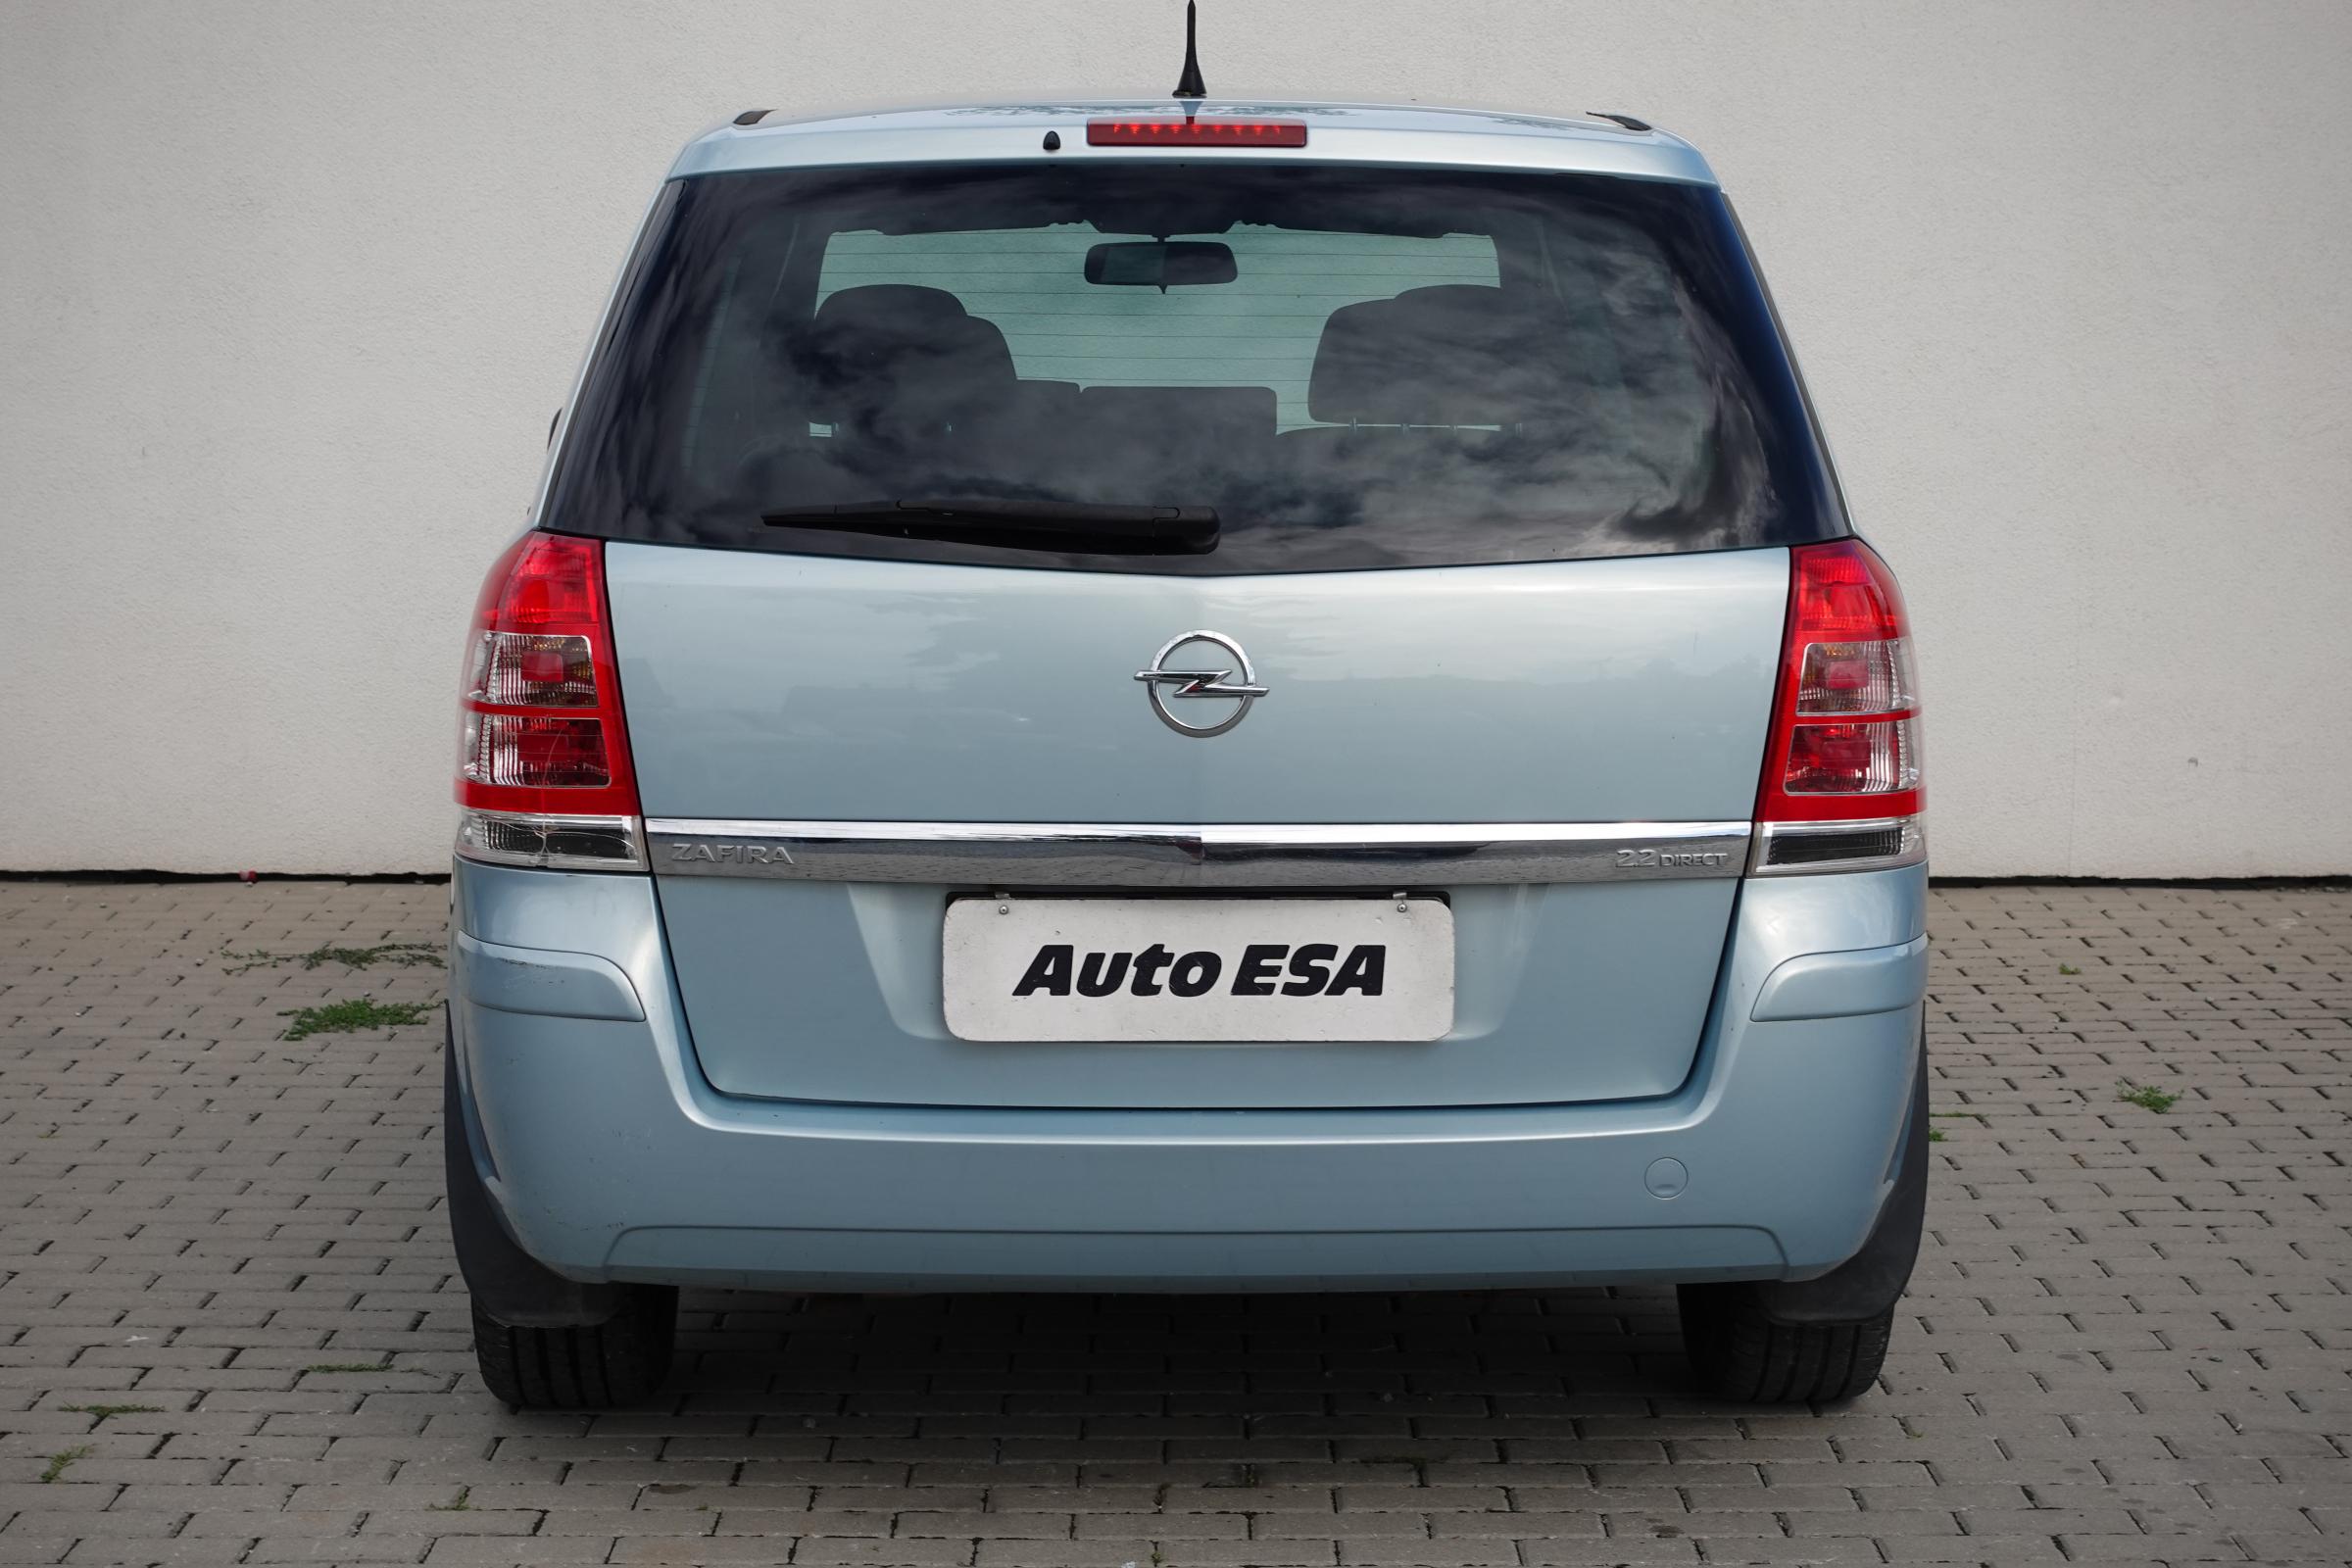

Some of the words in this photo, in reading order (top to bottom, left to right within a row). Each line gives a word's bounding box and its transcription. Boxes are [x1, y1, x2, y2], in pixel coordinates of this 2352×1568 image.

[671, 843, 795, 864] ZAFIRA
[1616, 849, 1656, 867] 2.2
[1659, 853, 1728, 867] DIRECT
[1011, 943, 1222, 998] Auto
[1230, 943, 1387, 997] ESA
